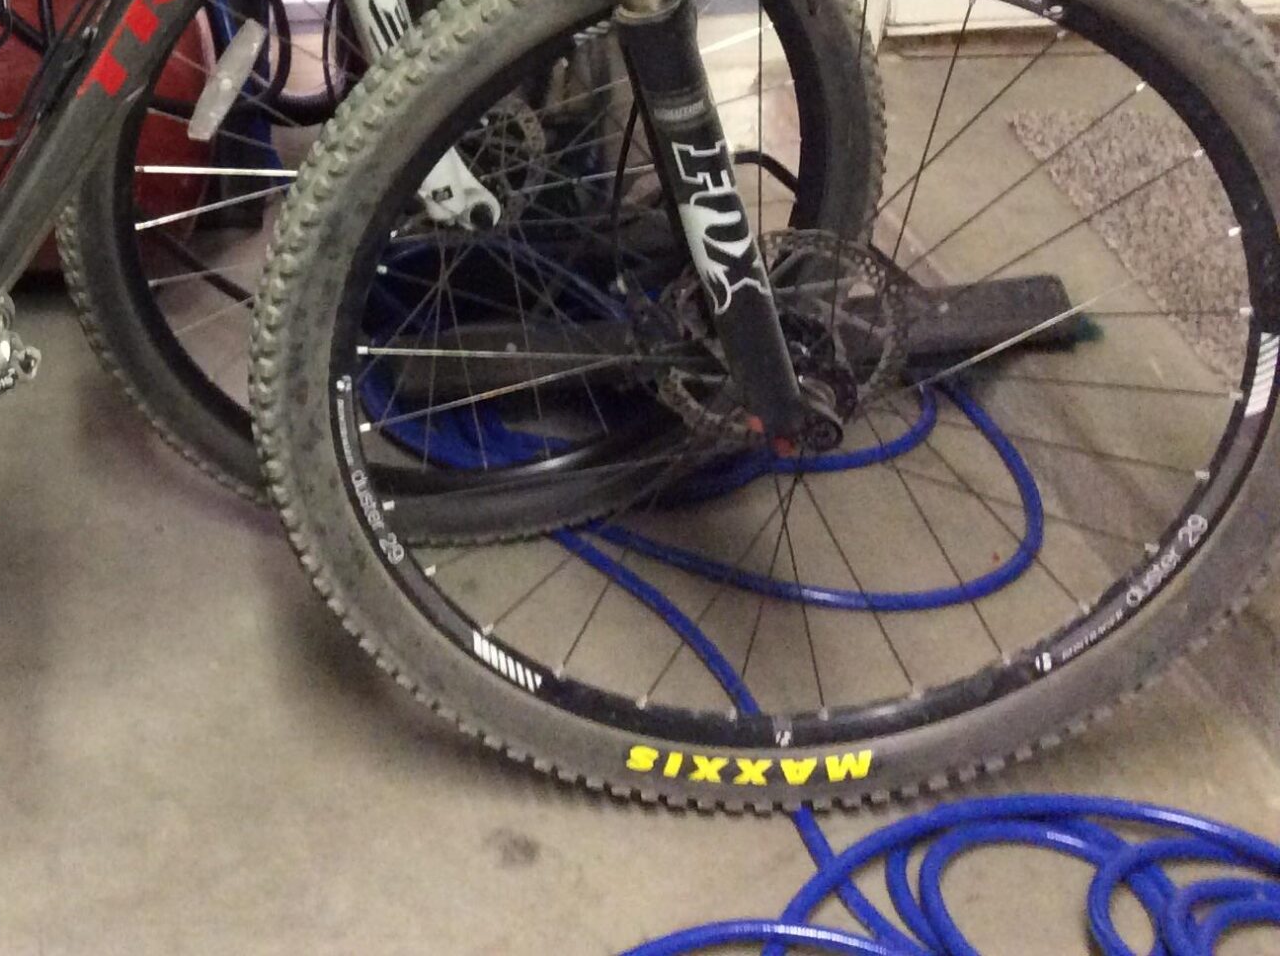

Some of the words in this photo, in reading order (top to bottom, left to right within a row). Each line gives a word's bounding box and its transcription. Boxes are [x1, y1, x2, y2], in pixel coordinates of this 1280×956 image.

[351, 469, 385, 531] duster
[379, 532, 405, 575] 29
[1177, 514, 1209, 548] 29
[625, 745, 872, 786] MAXXIS
